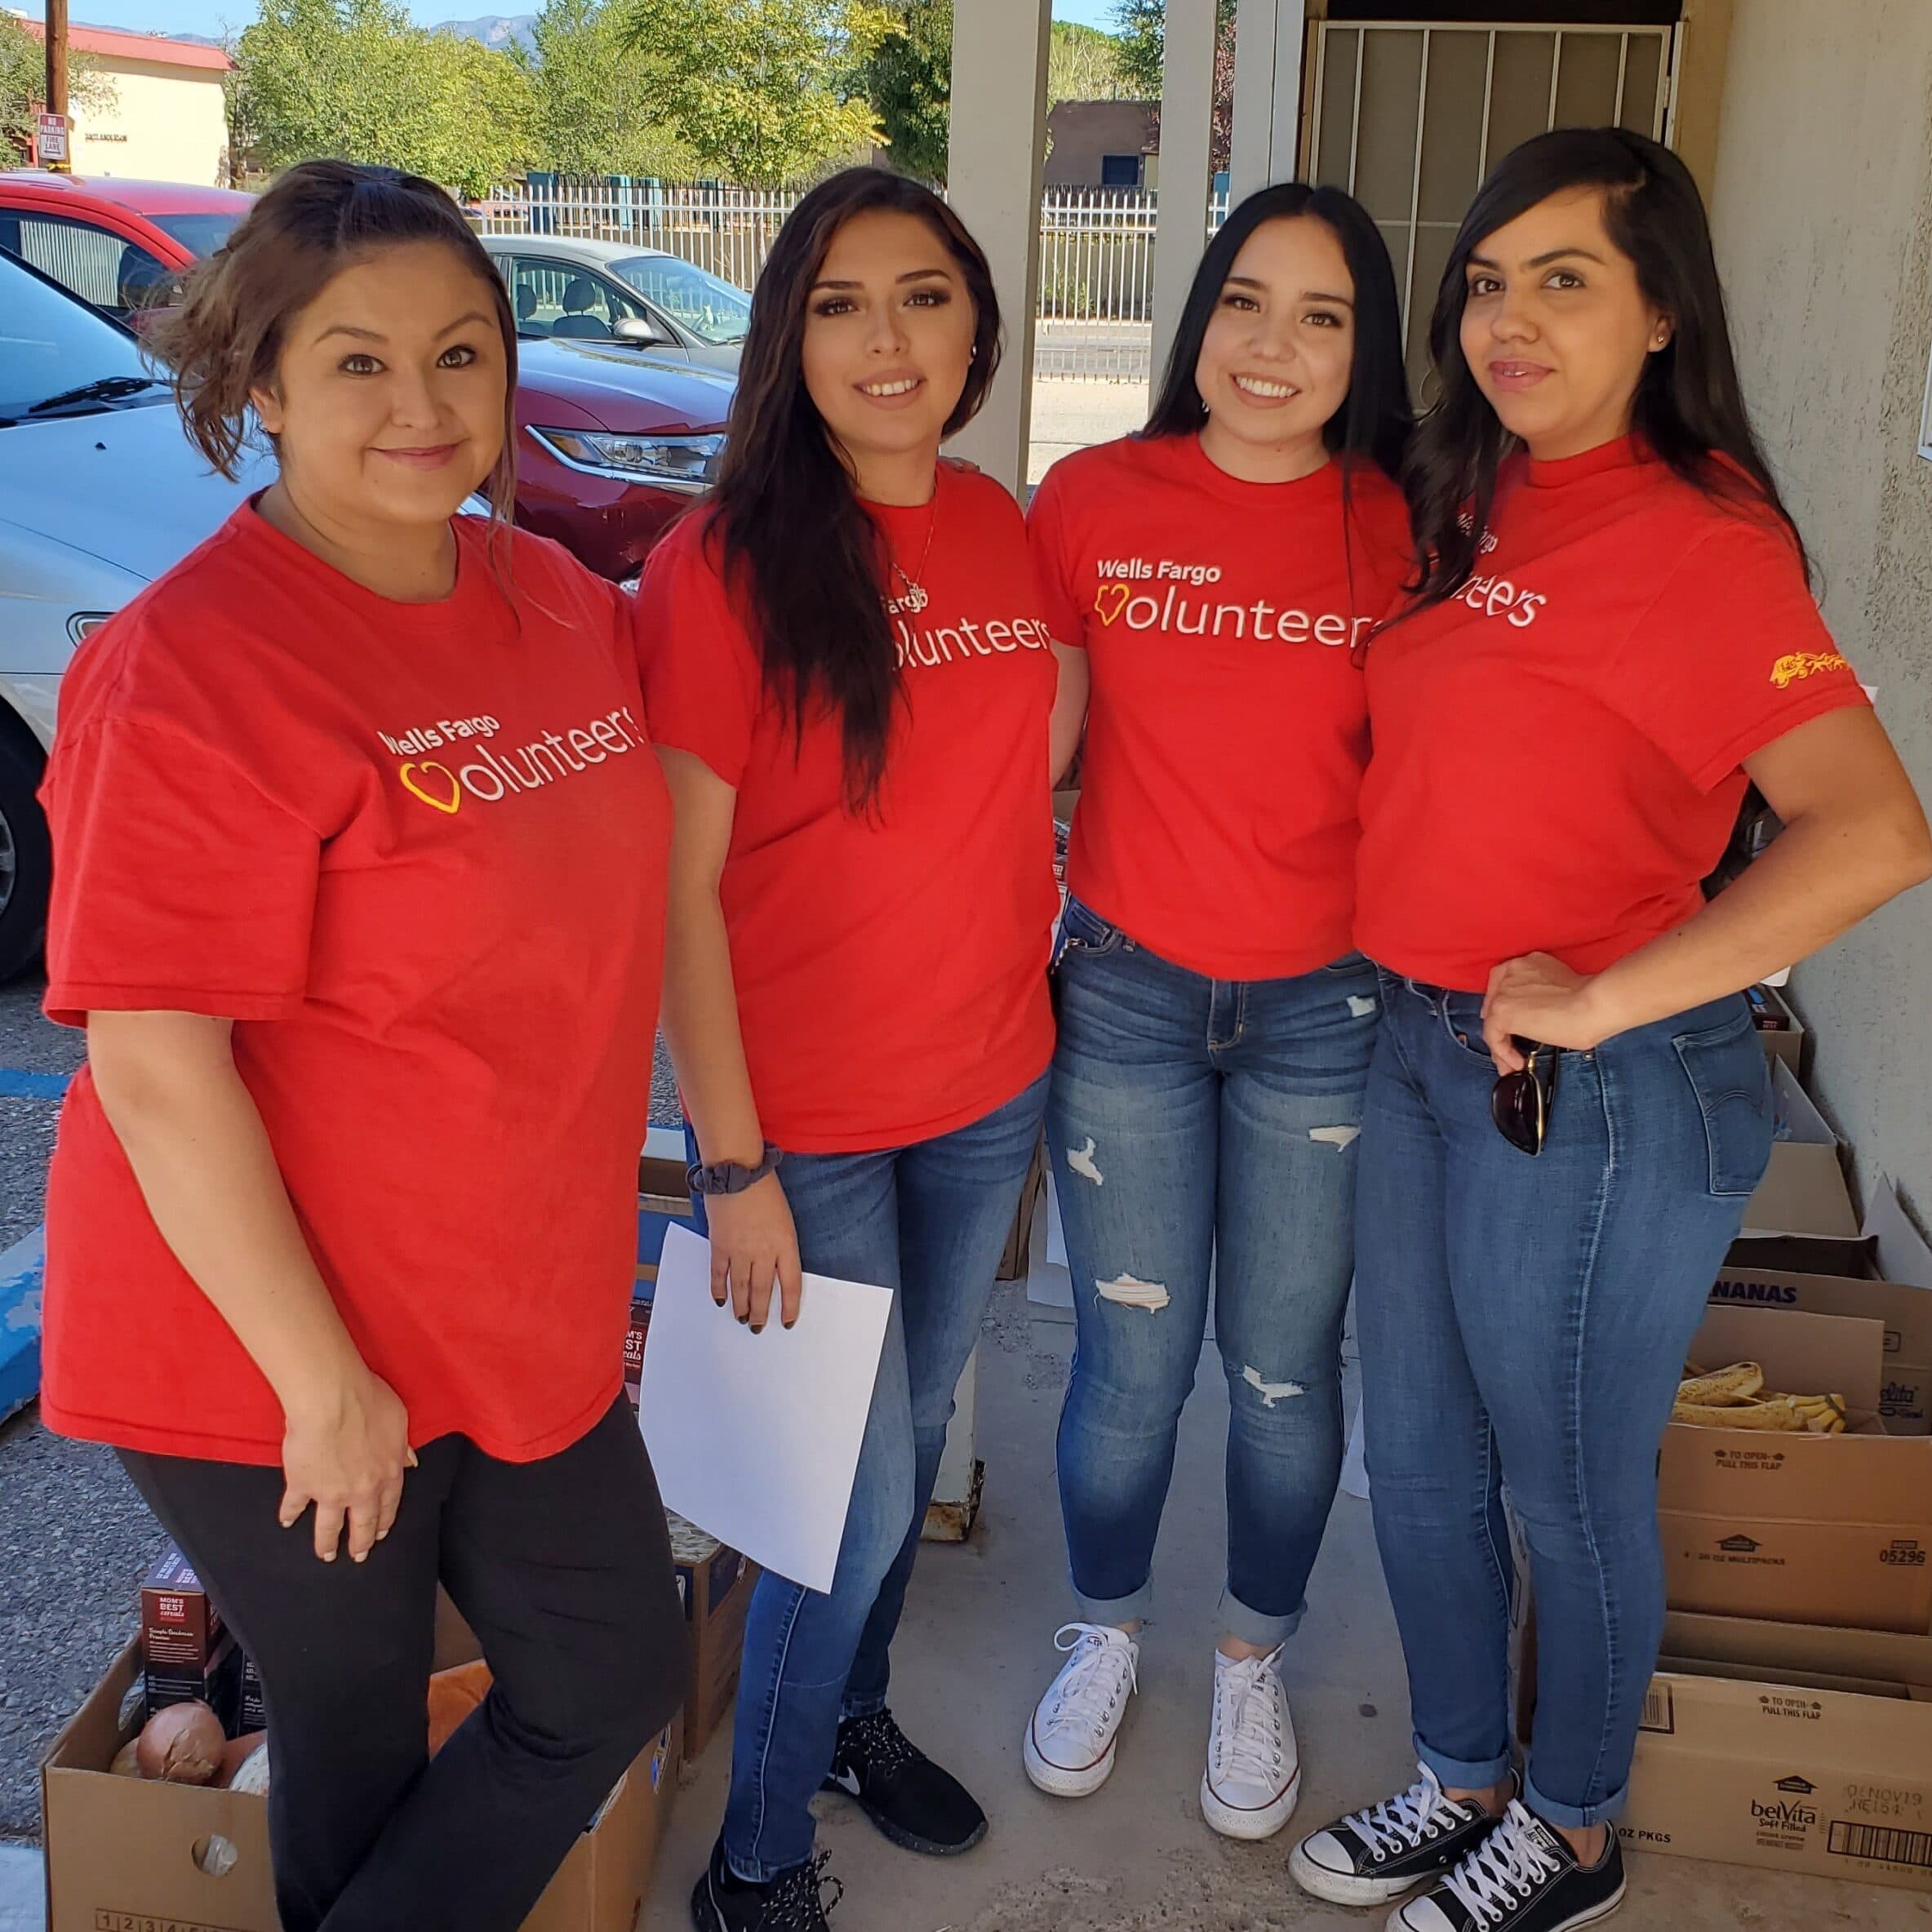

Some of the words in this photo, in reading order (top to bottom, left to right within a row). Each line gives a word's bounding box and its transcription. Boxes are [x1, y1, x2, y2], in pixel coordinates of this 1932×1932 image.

[48, 117, 56, 126] NO
[40, 125, 64, 135] PARKING
[45, 142, 60, 150] LANE
[46, 135, 59, 144] FIRE
[1097, 558, 1153, 580] Wells
[1157, 561, 1221, 586] Fargo
[883, 592, 929, 613] argo
[437, 715, 500, 741] Fargo
[1711, 1281, 1797, 1304] NANAS
[626, 1330, 643, 1340] M'S
[625, 1339, 642, 1351] ST
[1730, 1450, 1741, 1459] TO
[1716, 1459, 1736, 1468] PULL
[1740, 1460, 1758, 1469] THIS
[1761, 1461, 1783, 1470] FLAP
[1880, 1549, 1926, 1563] 05296
[159, 1603, 184, 1613] BEST
[1772, 1696, 1783, 1706] TO
[1762, 1705, 1780, 1716] PULL
[1783, 1708, 1800, 1718] THIS
[1802, 1710, 1822, 1720] FLAP
[1751, 1798, 1816, 1825] belVita
[1759, 1818, 1779, 1828] Soft
[1781, 1820, 1806, 1833] Filled
[1619, 1828, 1635, 1838] OZ
[1638, 1830, 1672, 1843] PKGS
[102, 1914, 110, 1927] 1
[125, 1918, 133, 1930] 2
[146, 1921, 155, 1932] 3
